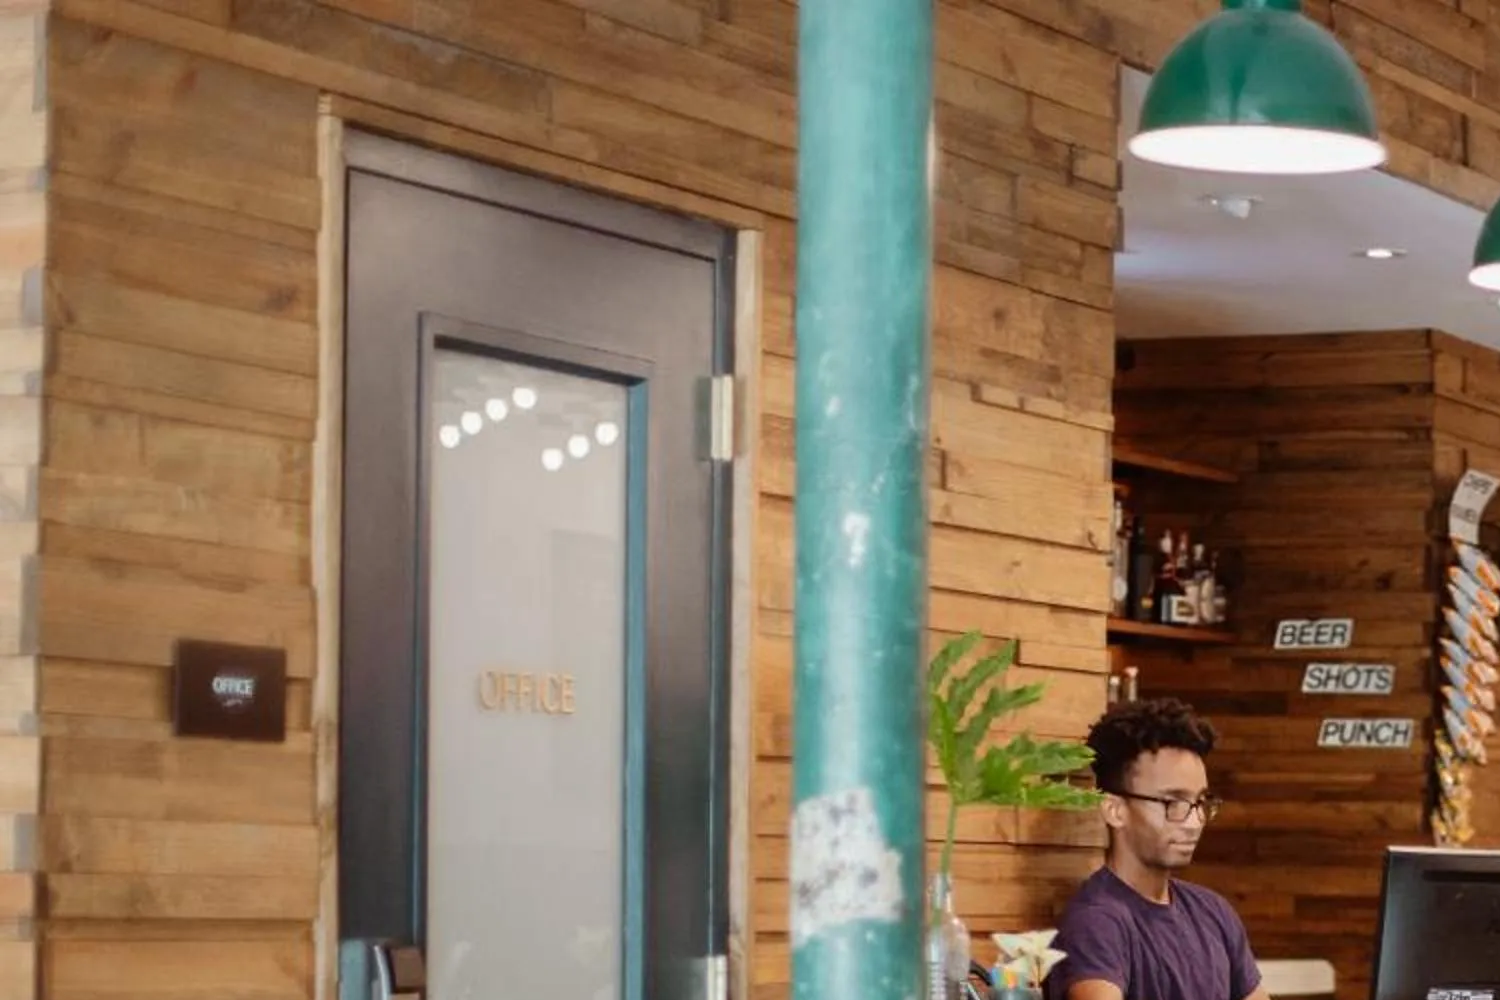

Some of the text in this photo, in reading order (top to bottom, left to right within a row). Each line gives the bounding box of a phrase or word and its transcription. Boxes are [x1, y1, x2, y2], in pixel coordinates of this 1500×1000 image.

[1279, 622, 1348, 645] BEER
[212, 676, 254, 696] OFFICE
[1306, 666, 1391, 690] SHOTS
[478, 670, 576, 714] OFFICE
[1322, 721, 1410, 744] PUNCH
